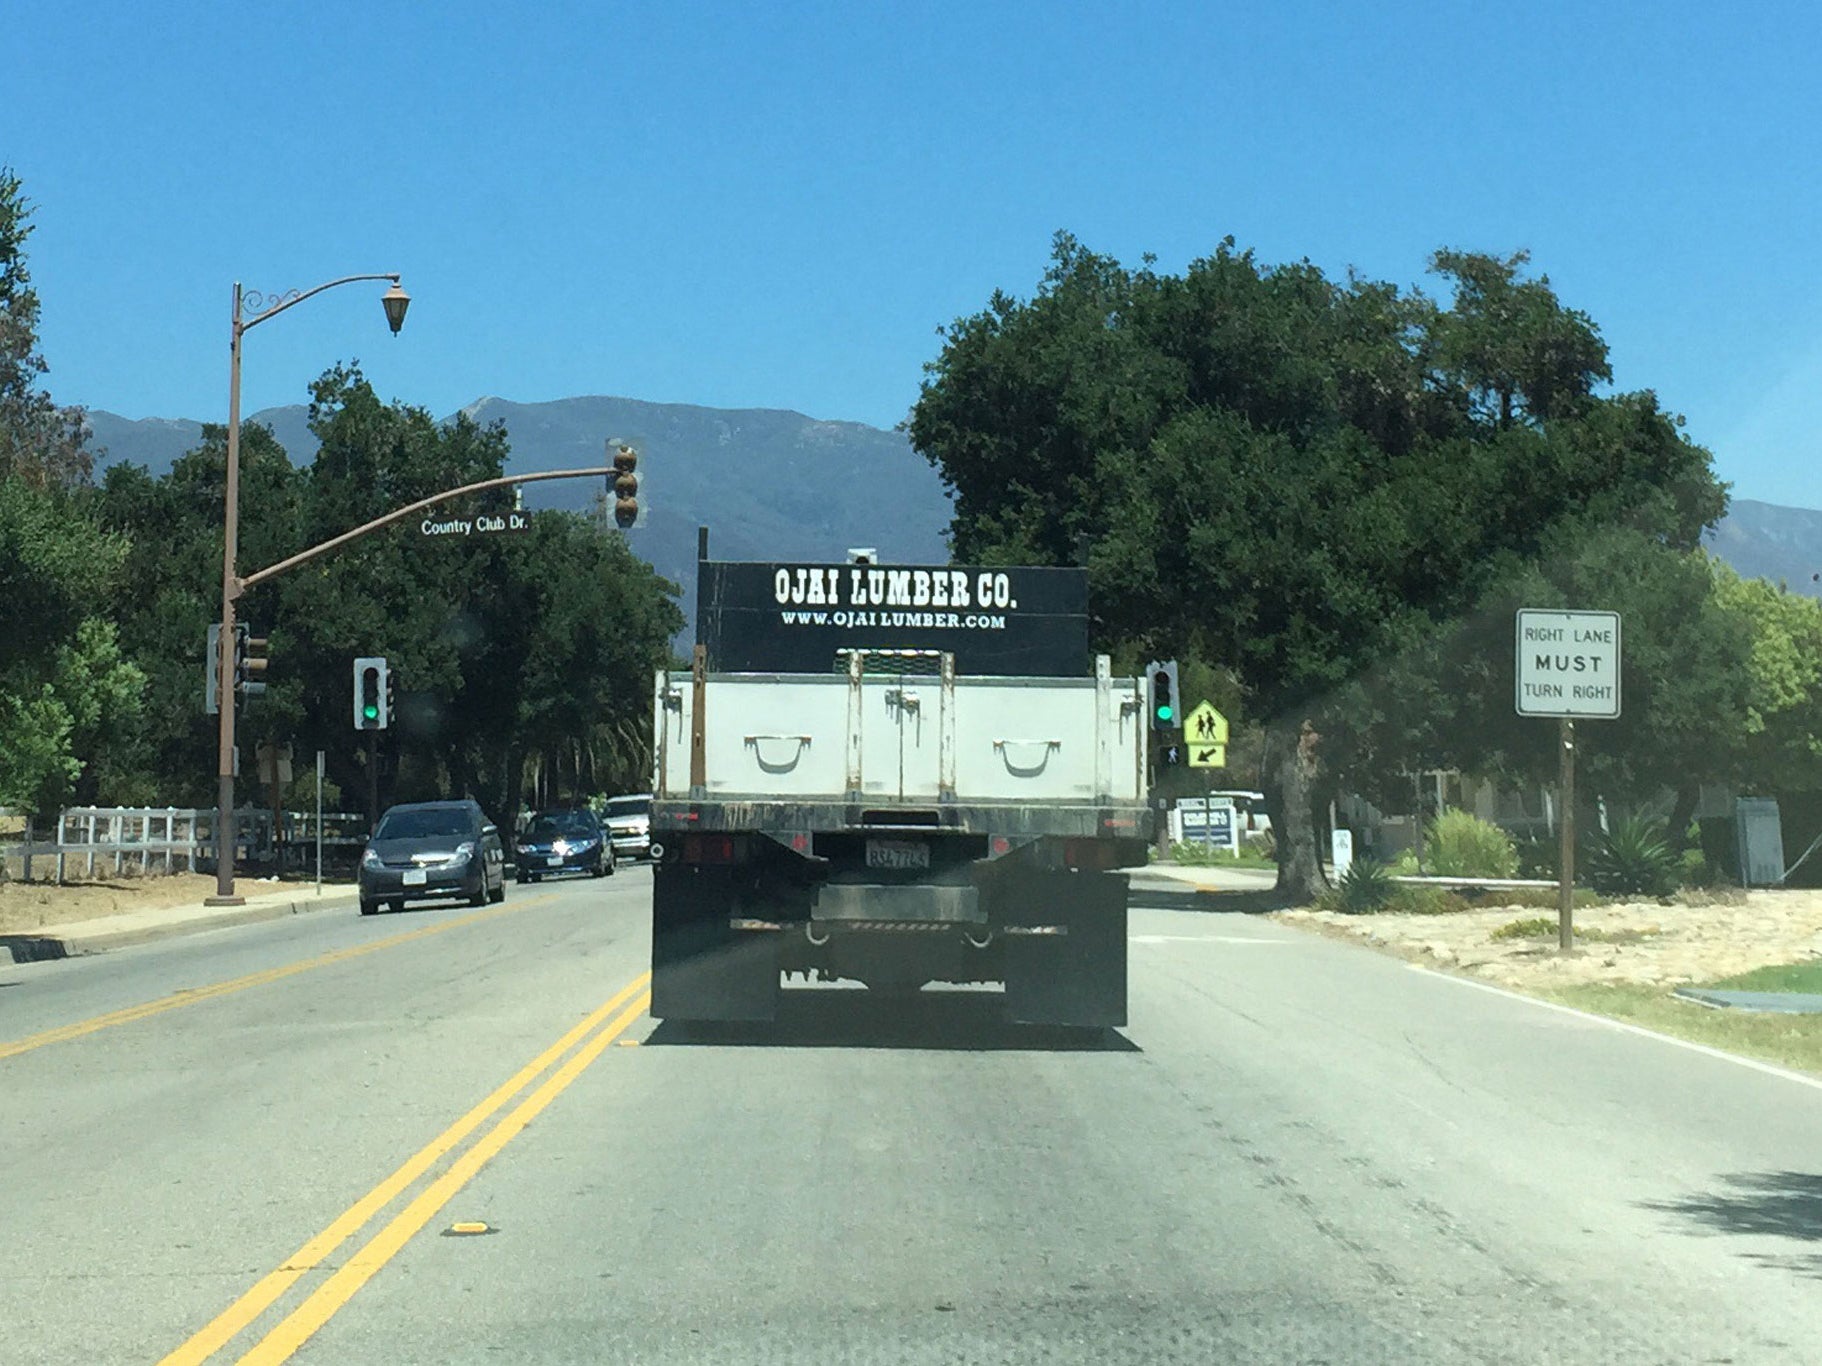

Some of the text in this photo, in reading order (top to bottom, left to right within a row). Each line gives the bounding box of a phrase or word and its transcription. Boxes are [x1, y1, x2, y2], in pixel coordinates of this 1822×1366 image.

[421, 519, 472, 536] Country
[476, 516, 505, 532] Club
[774, 567, 1017, 609] OJAI LUMBER CO.
[1525, 627, 1612, 644] RIGHT LANE
[1535, 654, 1603, 673] MUST
[1524, 683, 1612, 700] TURN RIGHT
